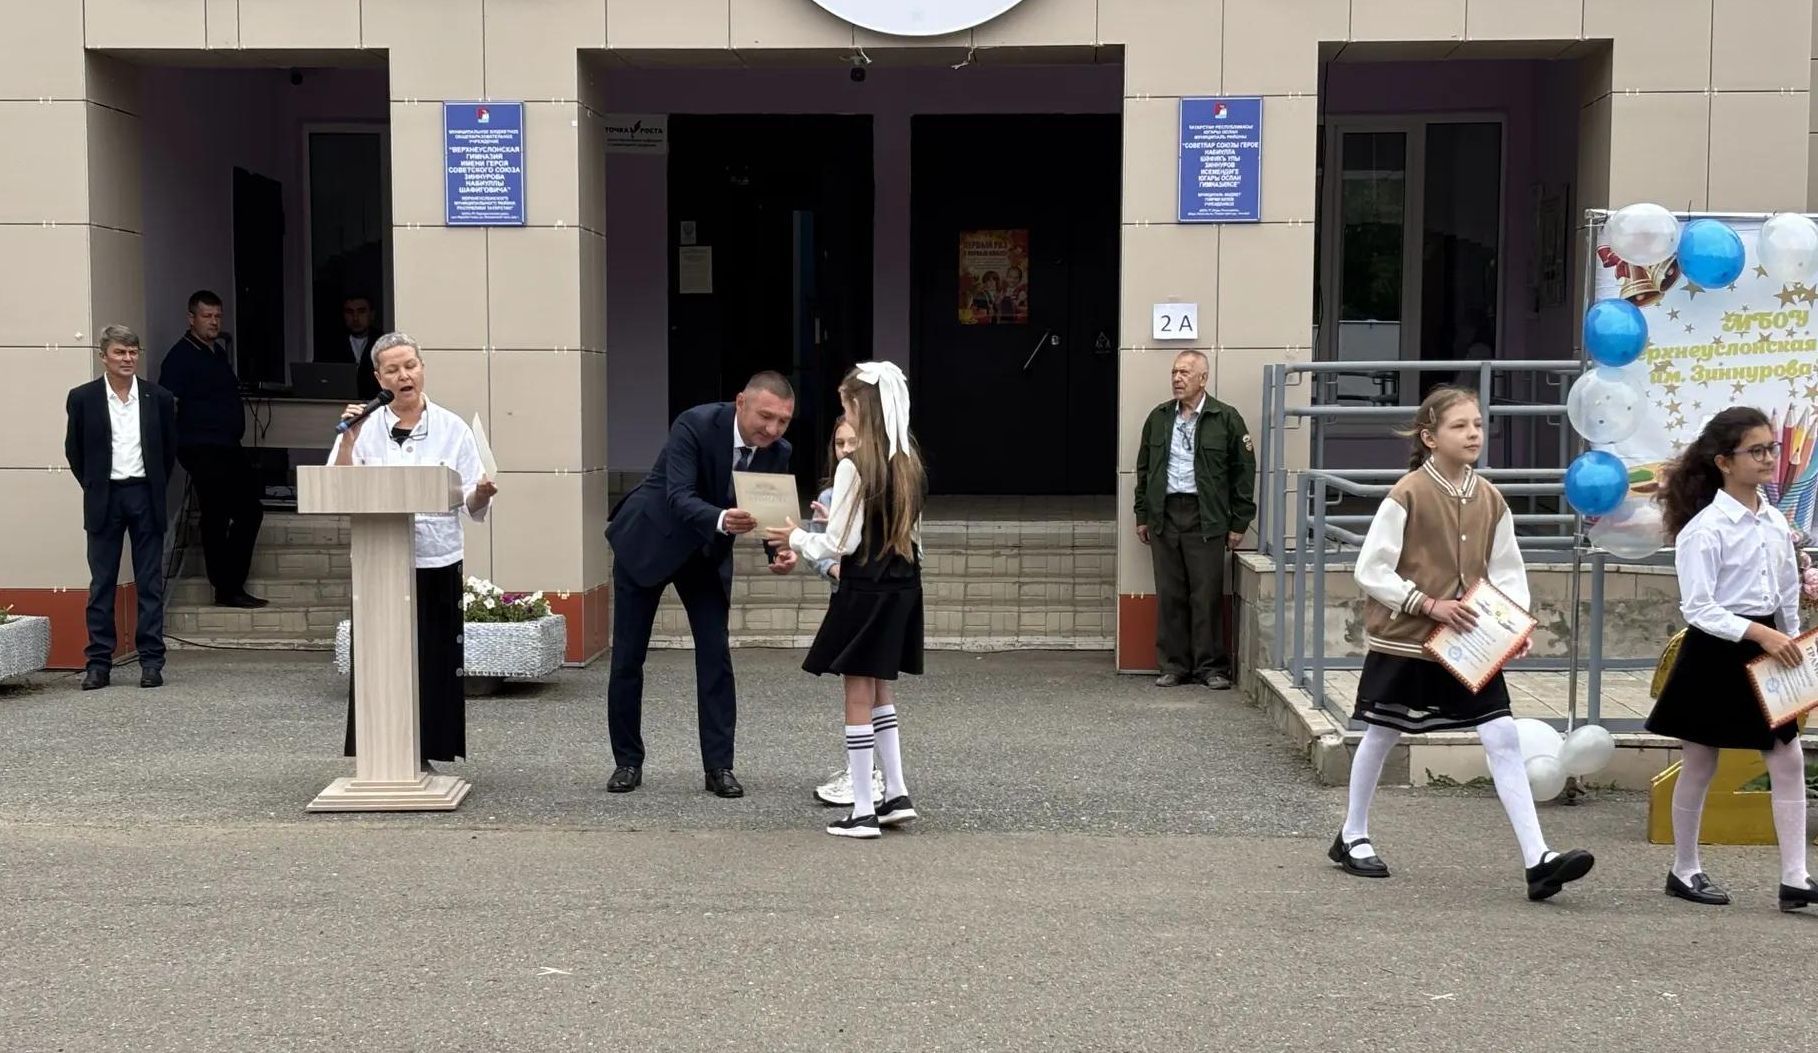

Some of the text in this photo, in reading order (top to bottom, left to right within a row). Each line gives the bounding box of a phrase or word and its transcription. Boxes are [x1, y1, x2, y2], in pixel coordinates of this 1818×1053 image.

[1161, 314, 1193, 332] 2 А
[1722, 309, 1810, 332] МБОУ
[1650, 359, 1812, 384] им. Зиннурова
